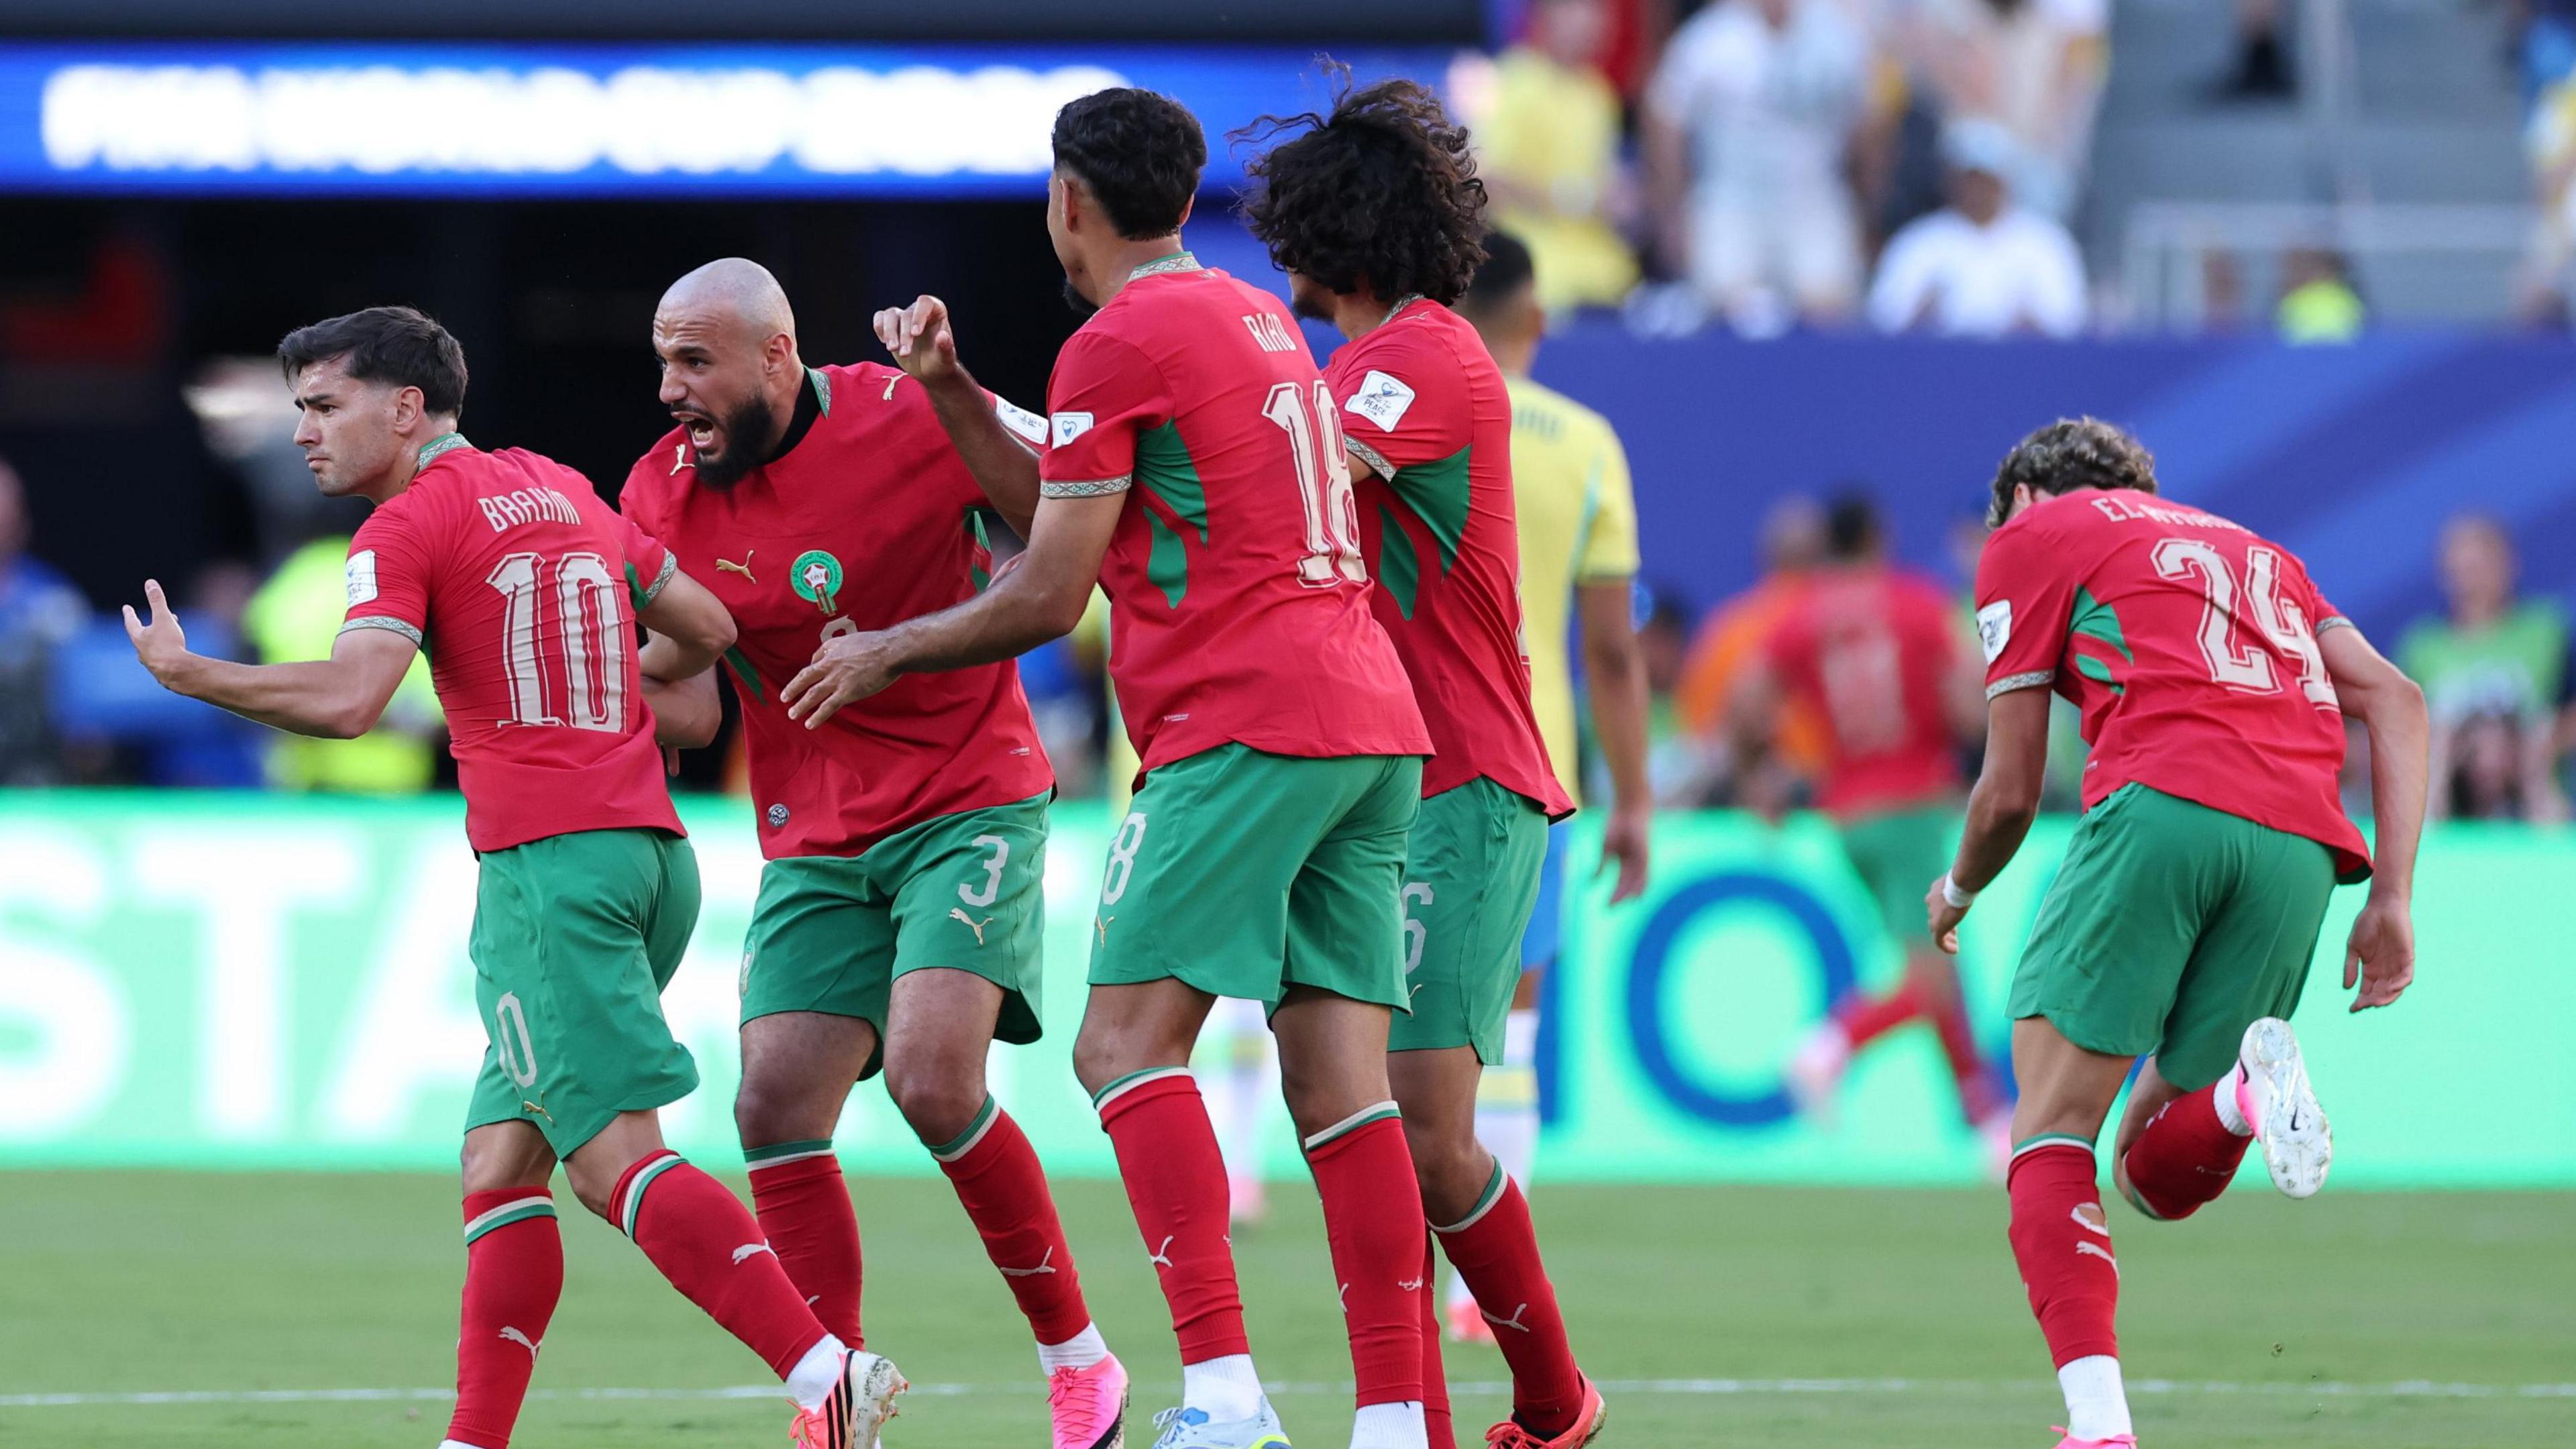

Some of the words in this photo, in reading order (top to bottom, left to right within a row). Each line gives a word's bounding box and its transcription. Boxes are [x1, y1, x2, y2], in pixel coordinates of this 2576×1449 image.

[1242, 313, 1297, 353] RIAD
[1364, 399, 1386, 415] PEACE
[478, 486, 581, 533] BRAHIM
[1262, 380, 1367, 588] 18
[2090, 497, 2145, 522] EL
[485, 552, 629, 733] 10
[2149, 538, 2341, 712] 24
[957, 835, 1009, 907] 3
[1102, 812, 1148, 905] 8
[496, 991, 537, 1088] 0
